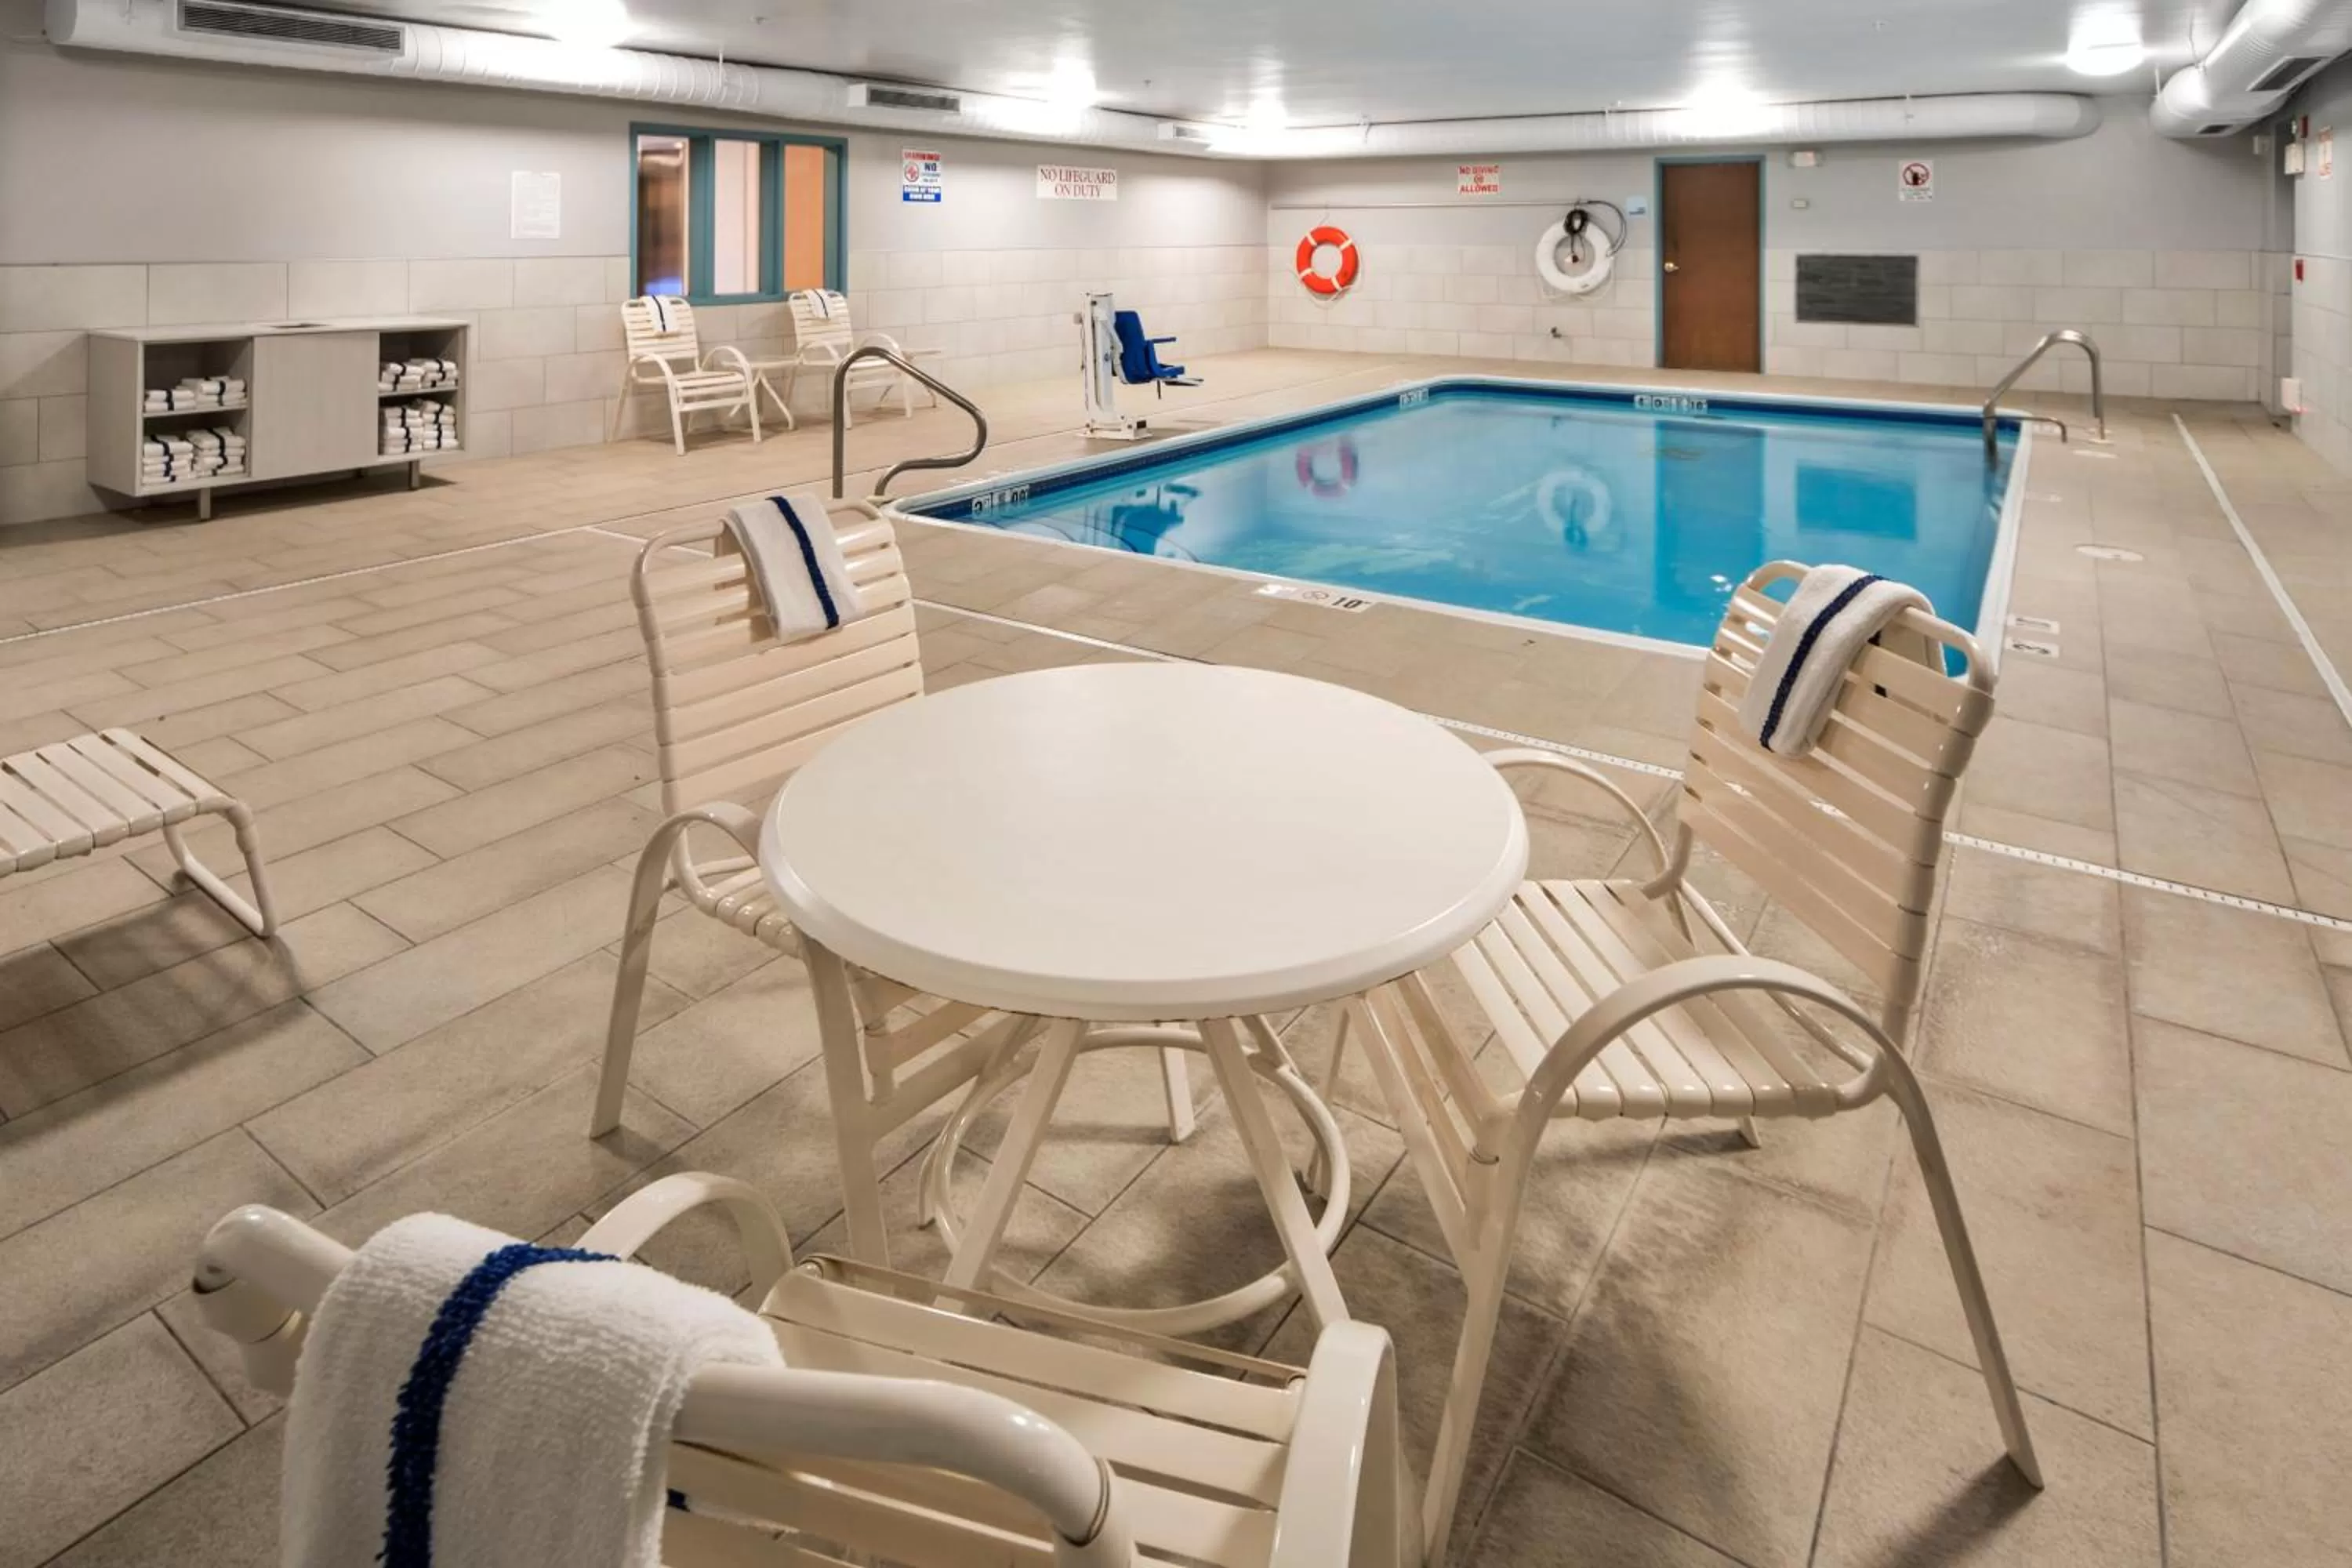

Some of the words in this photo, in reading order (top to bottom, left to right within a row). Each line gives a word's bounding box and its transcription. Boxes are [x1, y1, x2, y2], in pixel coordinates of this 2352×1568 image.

[924, 162, 937, 172] NO
[1460, 165, 1472, 174] NO
[1040, 169, 1057, 182] NO
[1059, 169, 1116, 184] LIFEGUARD
[1054, 183, 1071, 197] ON
[1073, 184, 1102, 198] DUTY
[1460, 184, 1498, 193] ALLOWED
[1332, 597, 1363, 609] 10
